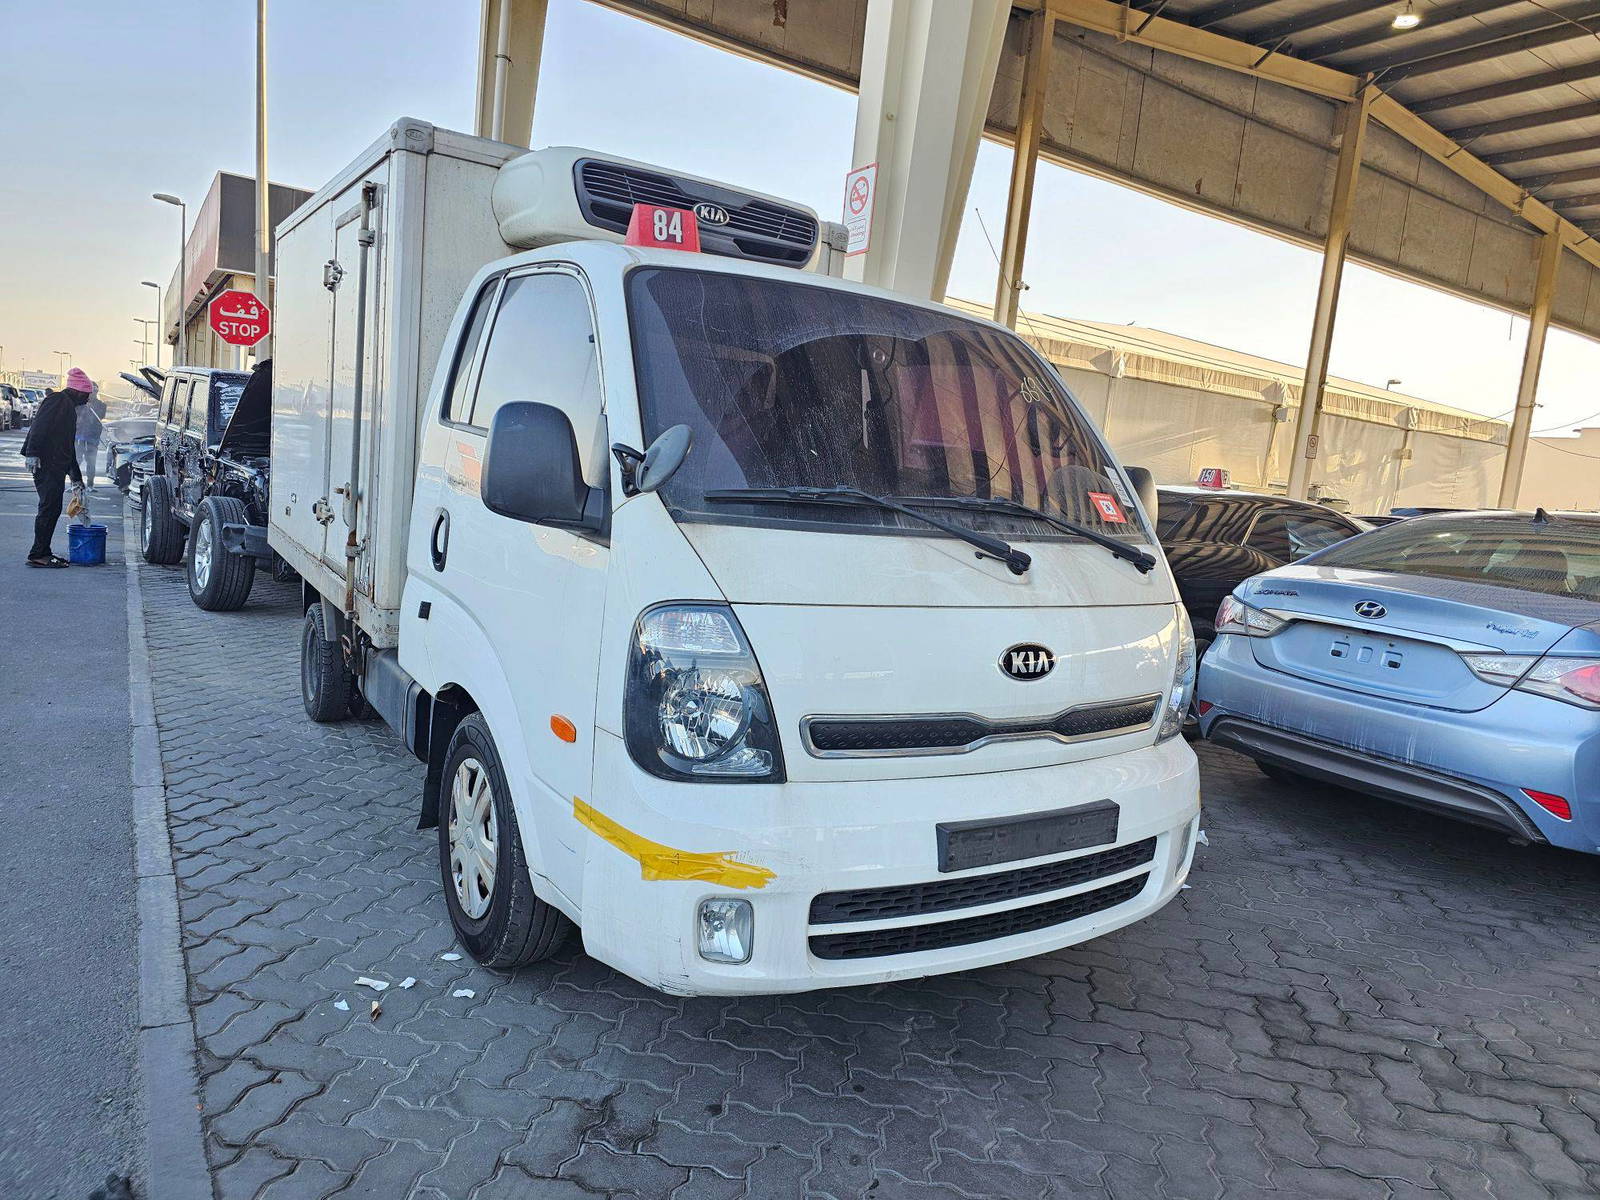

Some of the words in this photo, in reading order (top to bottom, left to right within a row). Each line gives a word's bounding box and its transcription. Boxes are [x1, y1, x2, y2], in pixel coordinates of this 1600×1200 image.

[700, 206, 724, 222] KIA
[653, 209, 682, 243] 84
[220, 301, 259, 320] قف
[219, 321, 260, 337] STOP
[1200, 469, 1216, 482] 150
[1010, 651, 1050, 674] KIA
